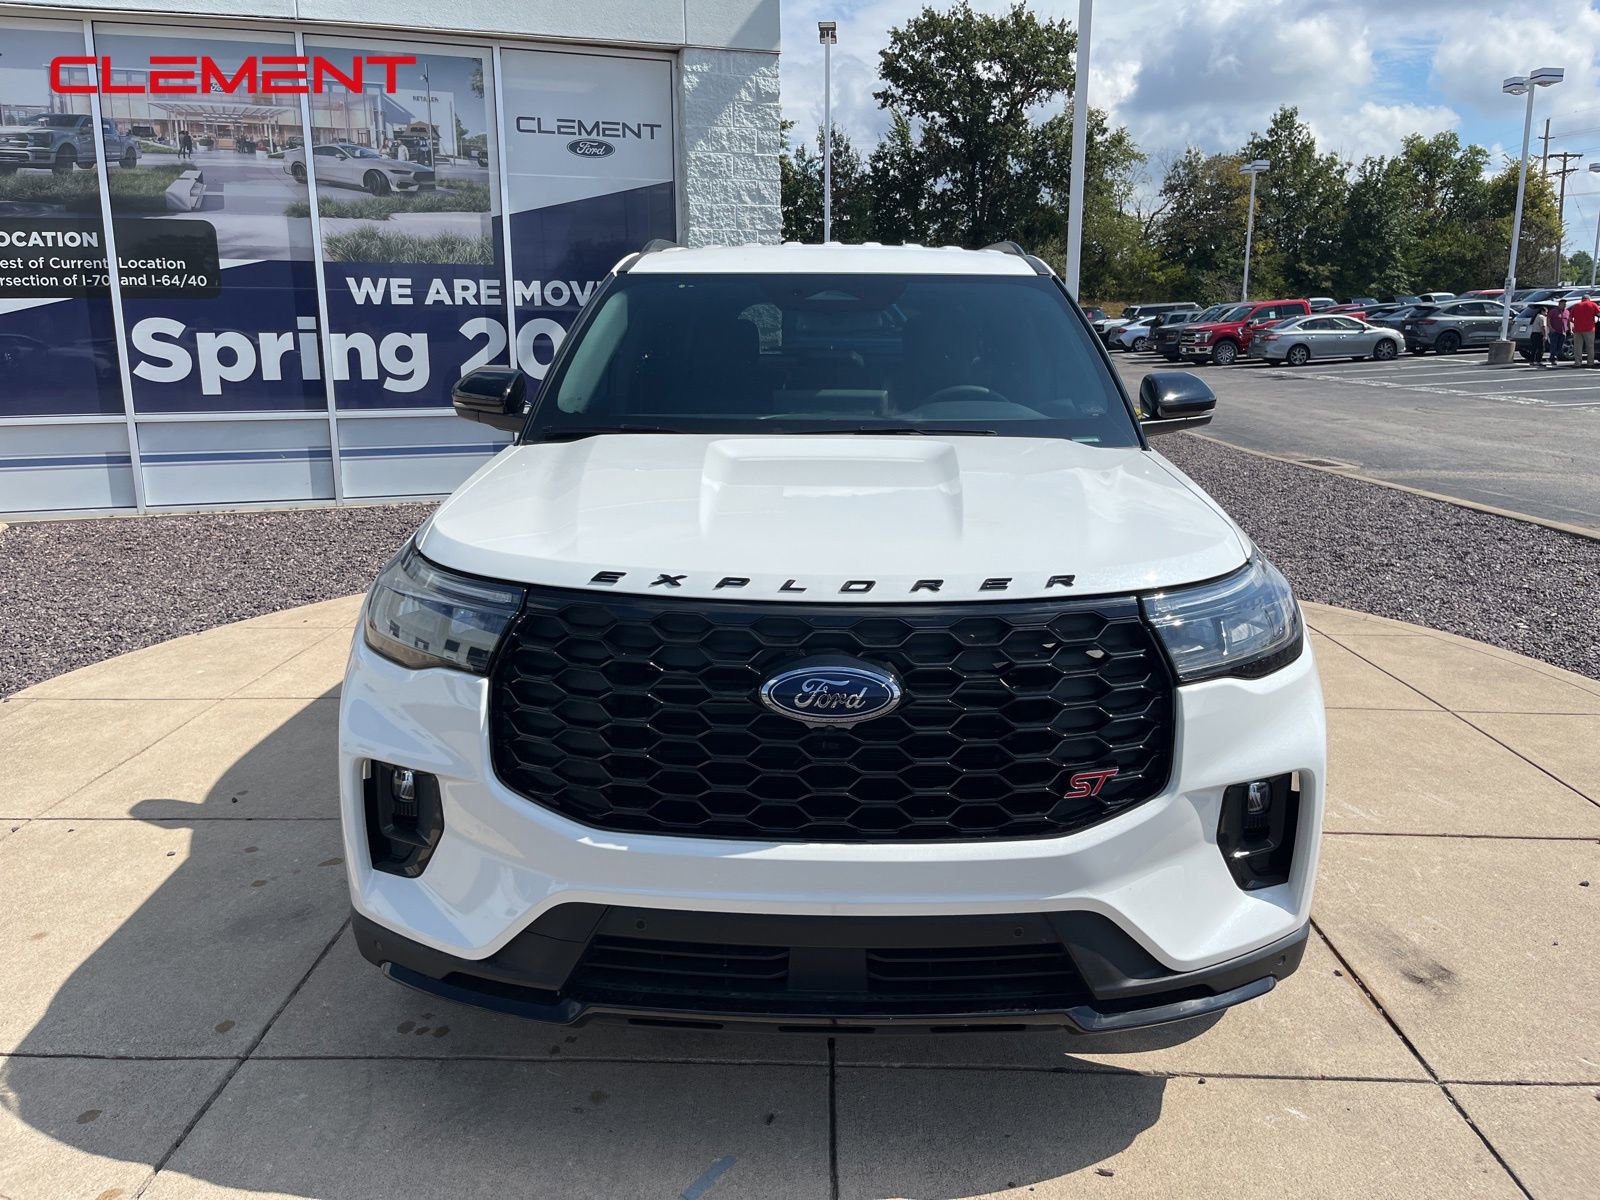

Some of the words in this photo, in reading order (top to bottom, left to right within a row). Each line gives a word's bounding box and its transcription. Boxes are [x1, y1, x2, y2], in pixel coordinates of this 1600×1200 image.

[516, 116, 662, 140] CLEMENT
[576, 141, 606, 156] Ford
[28, 256, 45, 269] of
[49, 257, 109, 269] Current
[118, 256, 186, 270] Location
[62, 274, 78, 287] of
[82, 274, 110, 287] I-70
[120, 274, 147, 287] and
[151, 274, 208, 289] I-64/40
[345, 277, 414, 305] WE
[424, 278, 502, 306] ARE
[515, 280, 602, 307] MOV
[131, 316, 430, 396] Spring
[591, 570, 1076, 594] EXPLORER
[794, 678, 868, 709] Ford
[1063, 769, 1119, 799] ST
